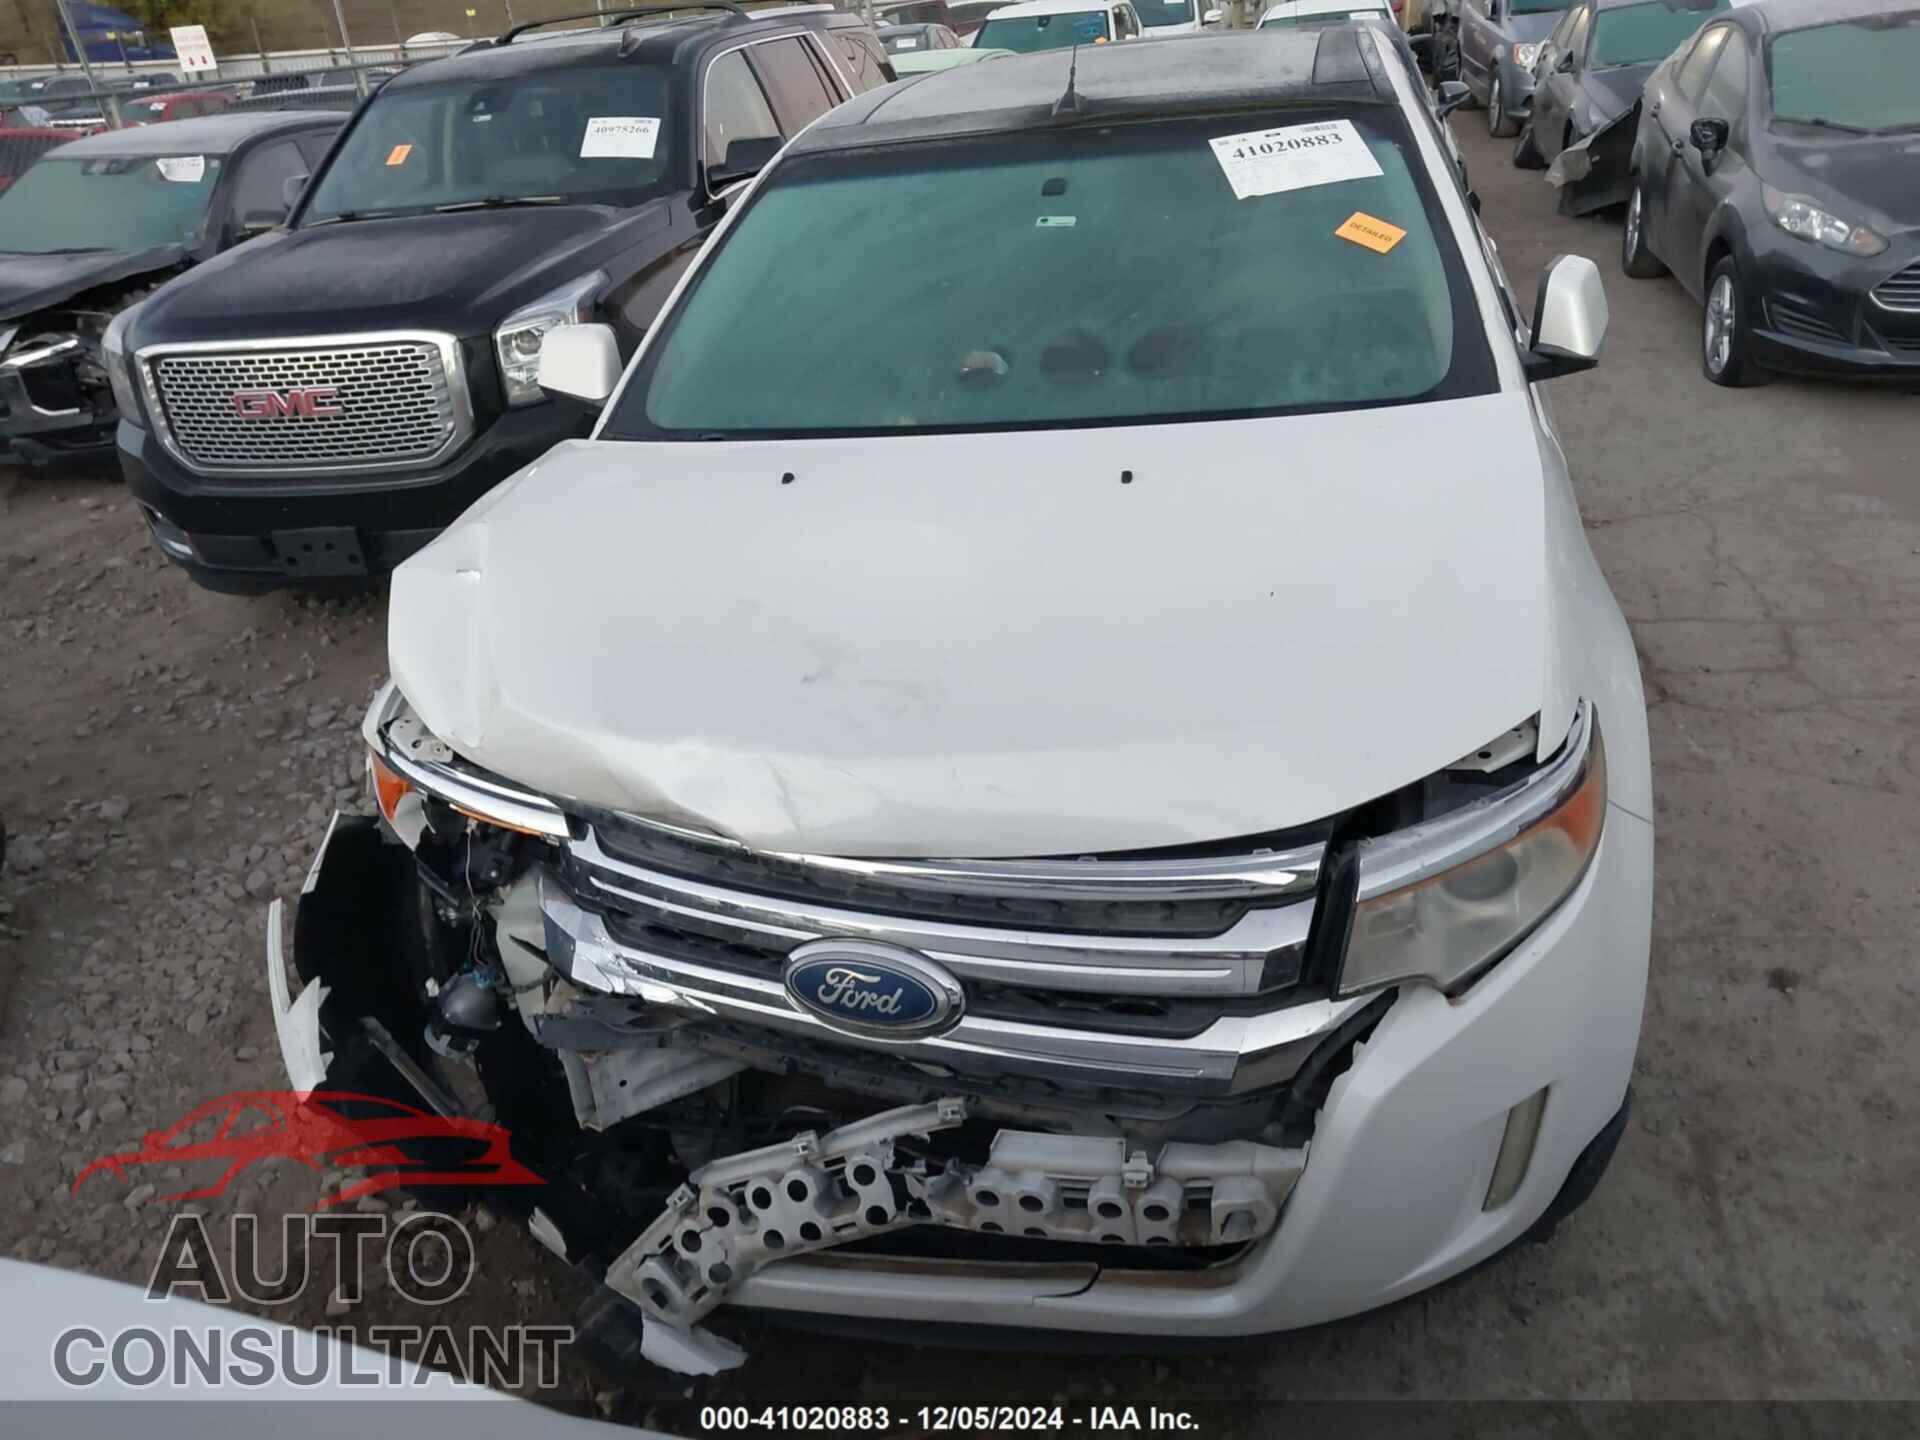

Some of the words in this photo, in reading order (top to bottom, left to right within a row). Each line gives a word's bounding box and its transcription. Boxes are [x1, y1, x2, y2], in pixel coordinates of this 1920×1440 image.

[1232, 132, 1344, 159] 41020883
[1350, 222, 1393, 243] DETAILED
[232, 387, 343, 418] GMC
[817, 967, 904, 1015] Ford
